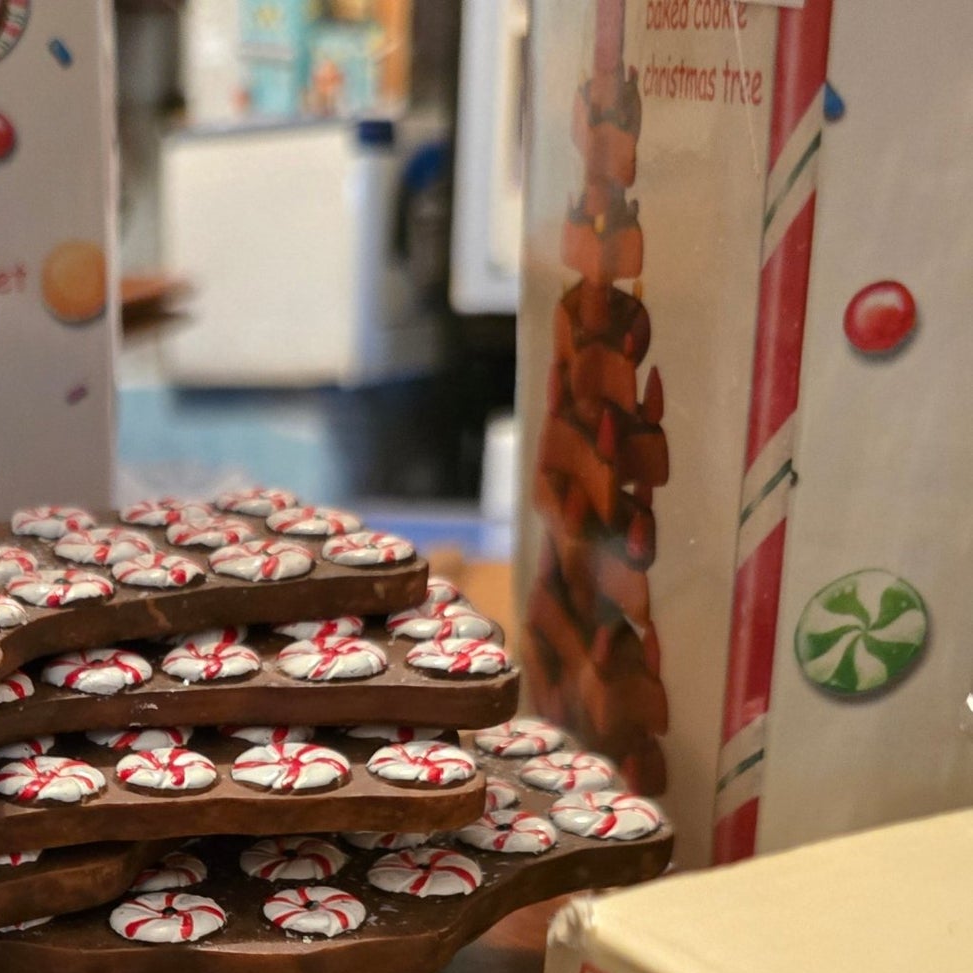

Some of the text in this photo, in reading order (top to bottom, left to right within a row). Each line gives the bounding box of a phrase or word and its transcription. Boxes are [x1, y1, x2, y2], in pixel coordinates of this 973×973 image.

[693, 0, 748, 30] cooke
[643, 53, 763, 105] christmas tree
